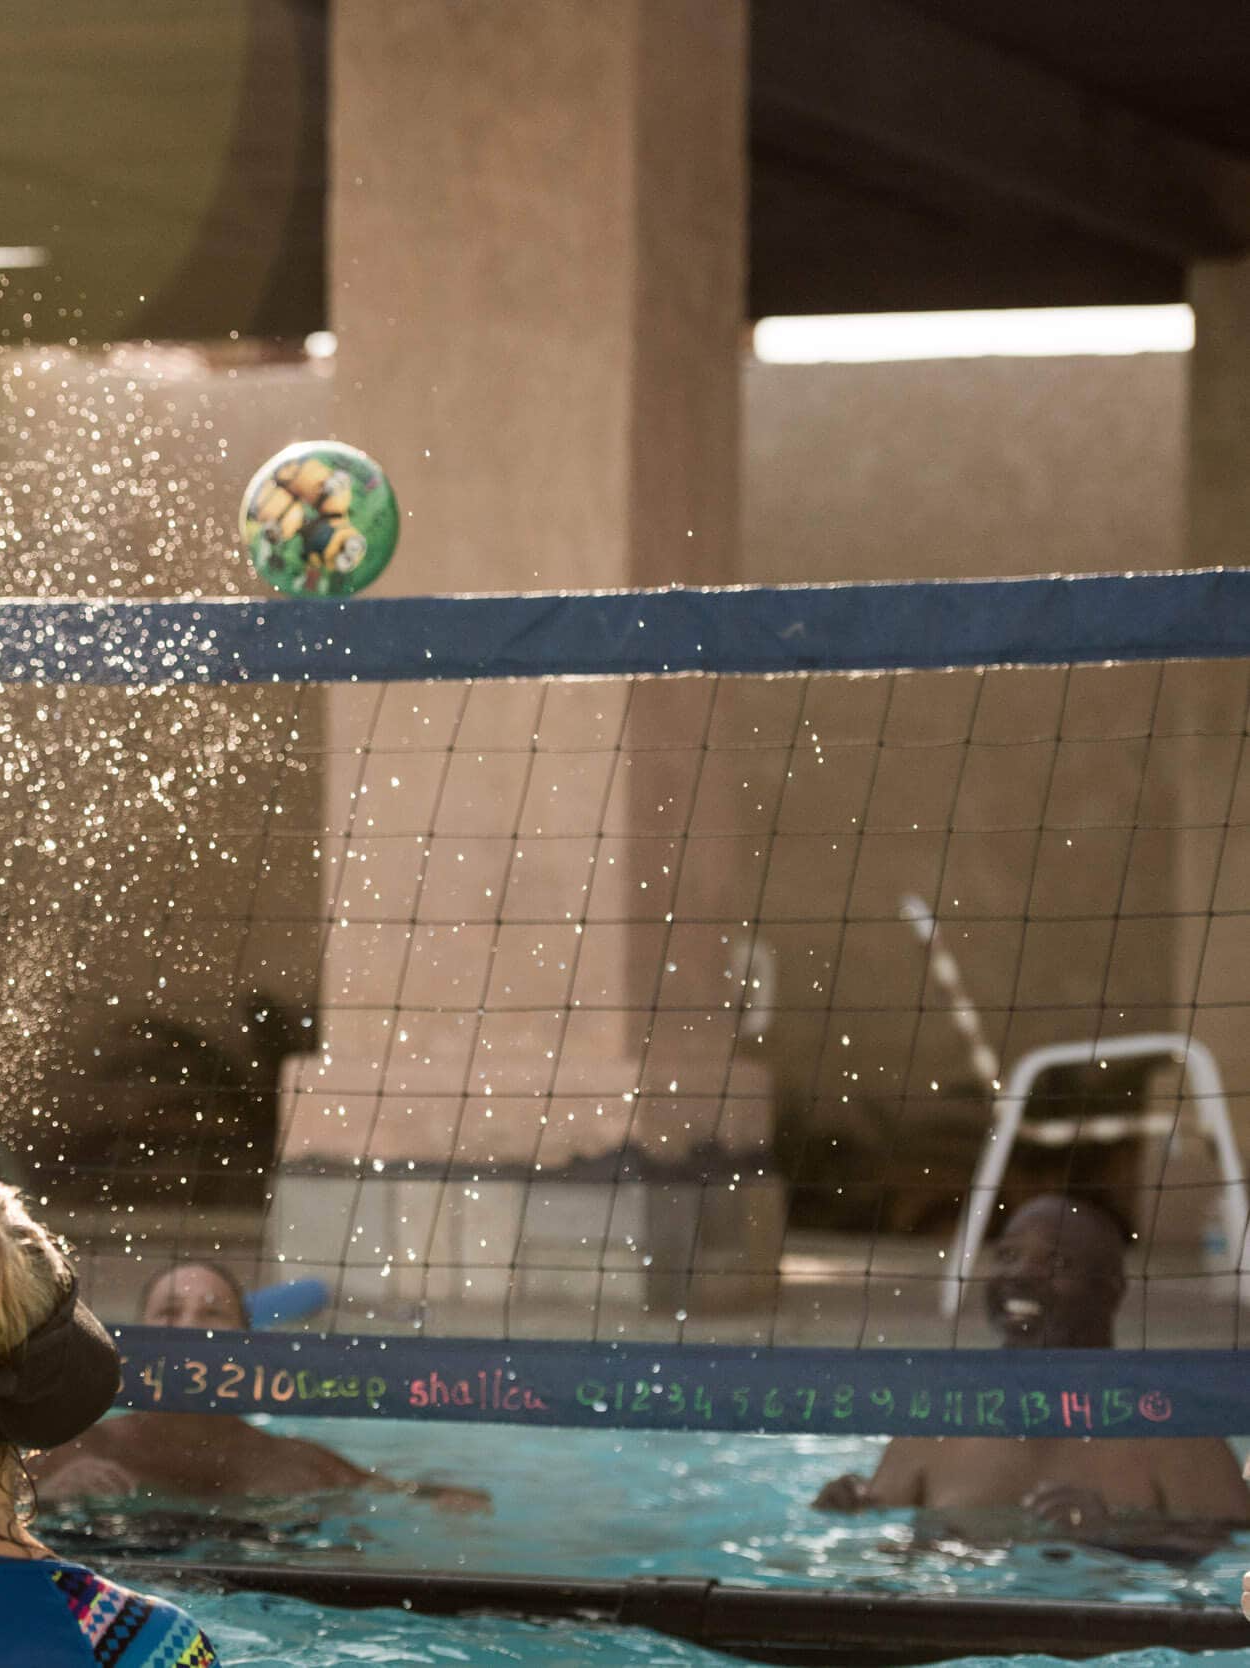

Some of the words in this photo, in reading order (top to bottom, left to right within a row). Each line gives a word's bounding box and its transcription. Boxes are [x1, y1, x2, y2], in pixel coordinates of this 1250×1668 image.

[143, 1356, 166, 1401] 4
[764, 1386, 784, 1418] 6
[798, 1388, 817, 1420] 7
[870, 1387, 895, 1417] 9
[977, 1389, 1006, 1425] 12
[1021, 1391, 1050, 1427] 13
[1061, 1391, 1093, 1429] 14
[1102, 1389, 1134, 1426] 15
